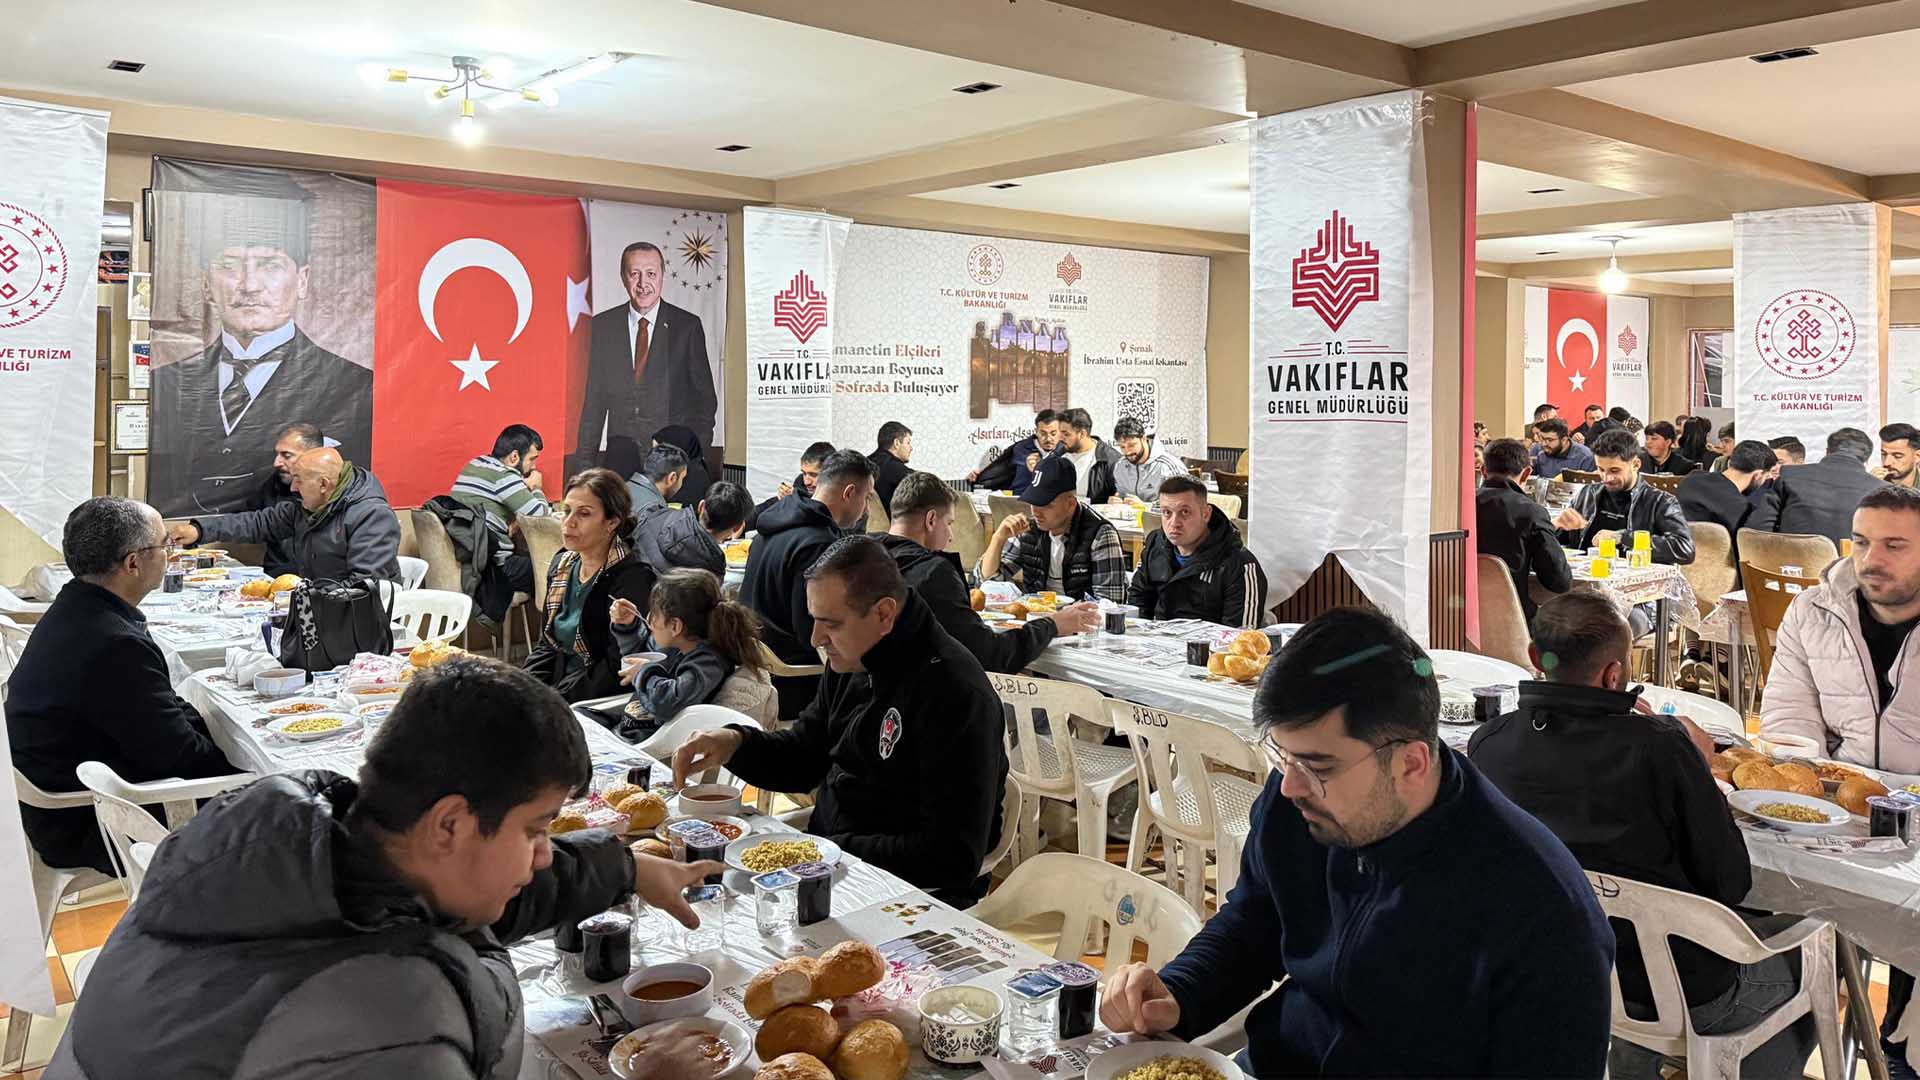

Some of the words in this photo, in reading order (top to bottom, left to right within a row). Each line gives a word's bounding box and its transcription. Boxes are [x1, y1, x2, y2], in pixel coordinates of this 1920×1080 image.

[955, 288, 986, 298] KÜLTÜR
[988, 291, 998, 299] VE
[1049, 293, 1088, 305] VAKIFLAR
[963, 299, 1006, 309] BAKANLIĞI
[19, 347, 71, 360] TURİZM
[834, 344, 892, 357] manetin
[895, 344, 941, 360] Elçileri
[1326, 341, 1345, 355] T.C.
[797, 350, 811, 359] T.C.
[757, 362, 830, 381] VAKIFLA
[832, 364, 884, 375] amazan
[889, 362, 944, 378] Boyunca
[1267, 361, 1408, 392] VAKIFLAR
[758, 385, 787, 396] GENEL
[835, 381, 889, 394] Sofrada
[893, 381, 959, 396] Buluşuyor
[1771, 391, 1807, 401] KÜLTÜR
[1809, 393, 1824, 401] VE
[1825, 393, 1863, 402] TURİZM
[1268, 400, 1310, 415] GENEL
[1317, 394, 1408, 415] MÜDÜRLÜĞÜ
[1780, 403, 1833, 411] BAKANLIĞI
[1174, 436, 1188, 447] için
